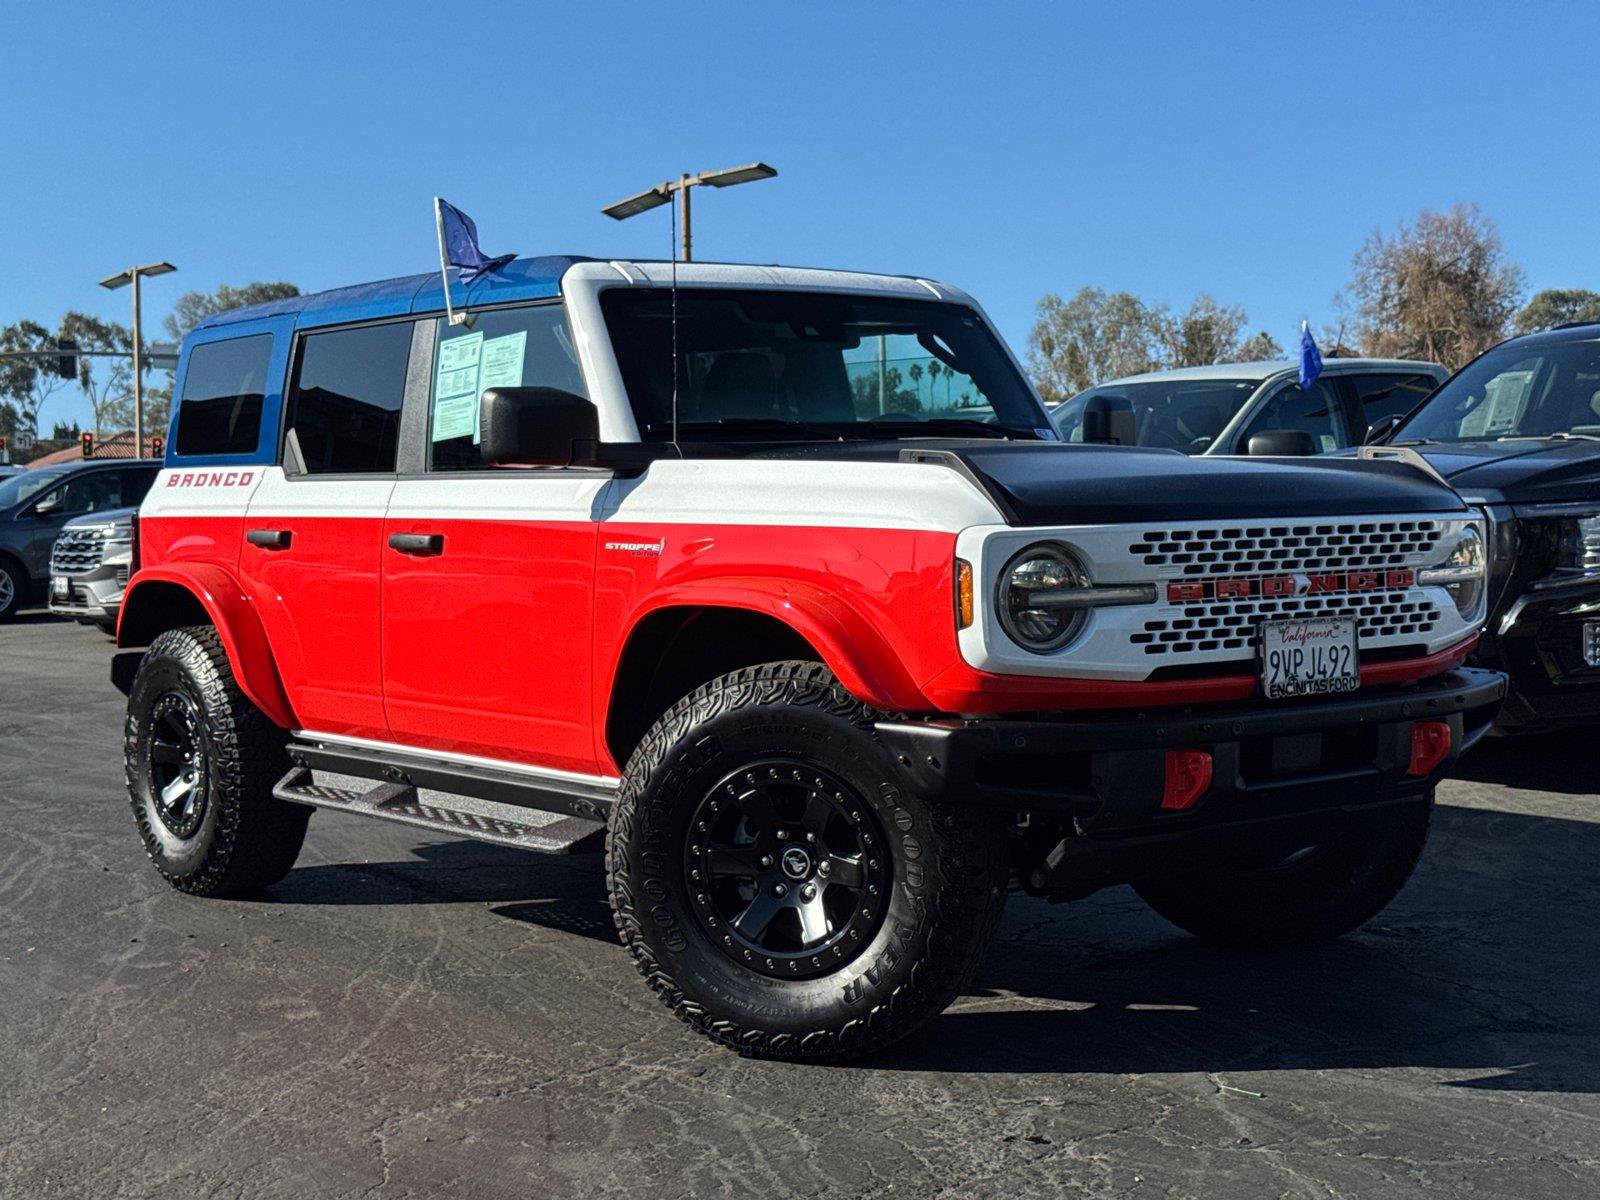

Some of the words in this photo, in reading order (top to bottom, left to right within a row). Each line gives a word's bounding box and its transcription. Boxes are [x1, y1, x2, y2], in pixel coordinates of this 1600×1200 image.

[166, 472, 254, 487] BRONCO
[605, 542, 661, 551] STROPPE
[1167, 569, 1414, 602] BRONCO
[1281, 625, 1338, 646] California
[1269, 644, 1351, 684] 9VPJ492
[1269, 680, 1328, 698] ENCINITAS
[1329, 677, 1357, 692] FORD
[842, 782, 926, 1005] GOODYEAR
